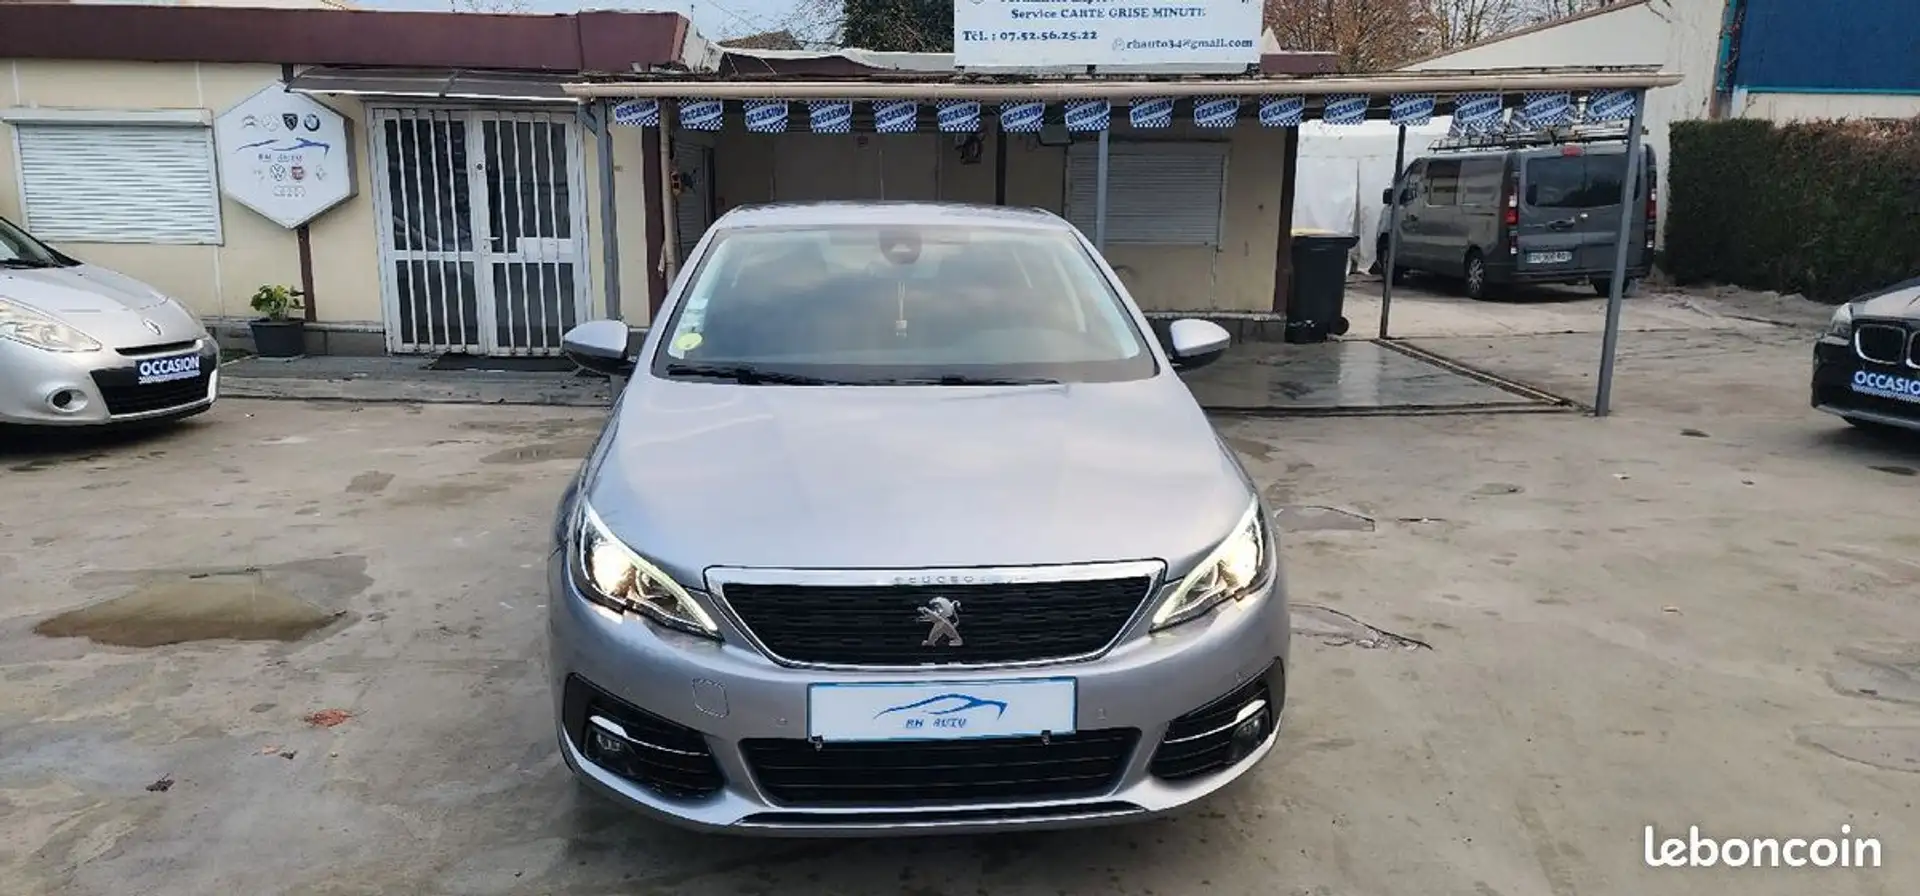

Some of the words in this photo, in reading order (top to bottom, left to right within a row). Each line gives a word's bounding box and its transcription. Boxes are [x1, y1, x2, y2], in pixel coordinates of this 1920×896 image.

[1011, 8, 1057, 19] Service
[1060, 8, 1105, 18] CARTE
[1108, 8, 1149, 18] GRISE
[1152, 8, 1206, 17] MINUTE
[1000, 31, 1097, 41] 07.52.56.25.22
[811, 104, 850, 125] OCCASION
[876, 103, 915, 124] OCCASION
[938, 103, 979, 124] OCCASION
[1002, 103, 1044, 125] OCCASION
[1067, 102, 1108, 124] OCCASION
[1132, 100, 1172, 120] OCCASION
[1195, 100, 1238, 120] OCCASION
[1261, 99, 1300, 120] OCCASION
[1325, 100, 1367, 120] OCCASION
[1391, 99, 1433, 119] OCCASION
[1457, 100, 1500, 119] OCCASION
[140, 356, 200, 376] OCCASION
[1854, 370, 1920, 395] OCCASIO
